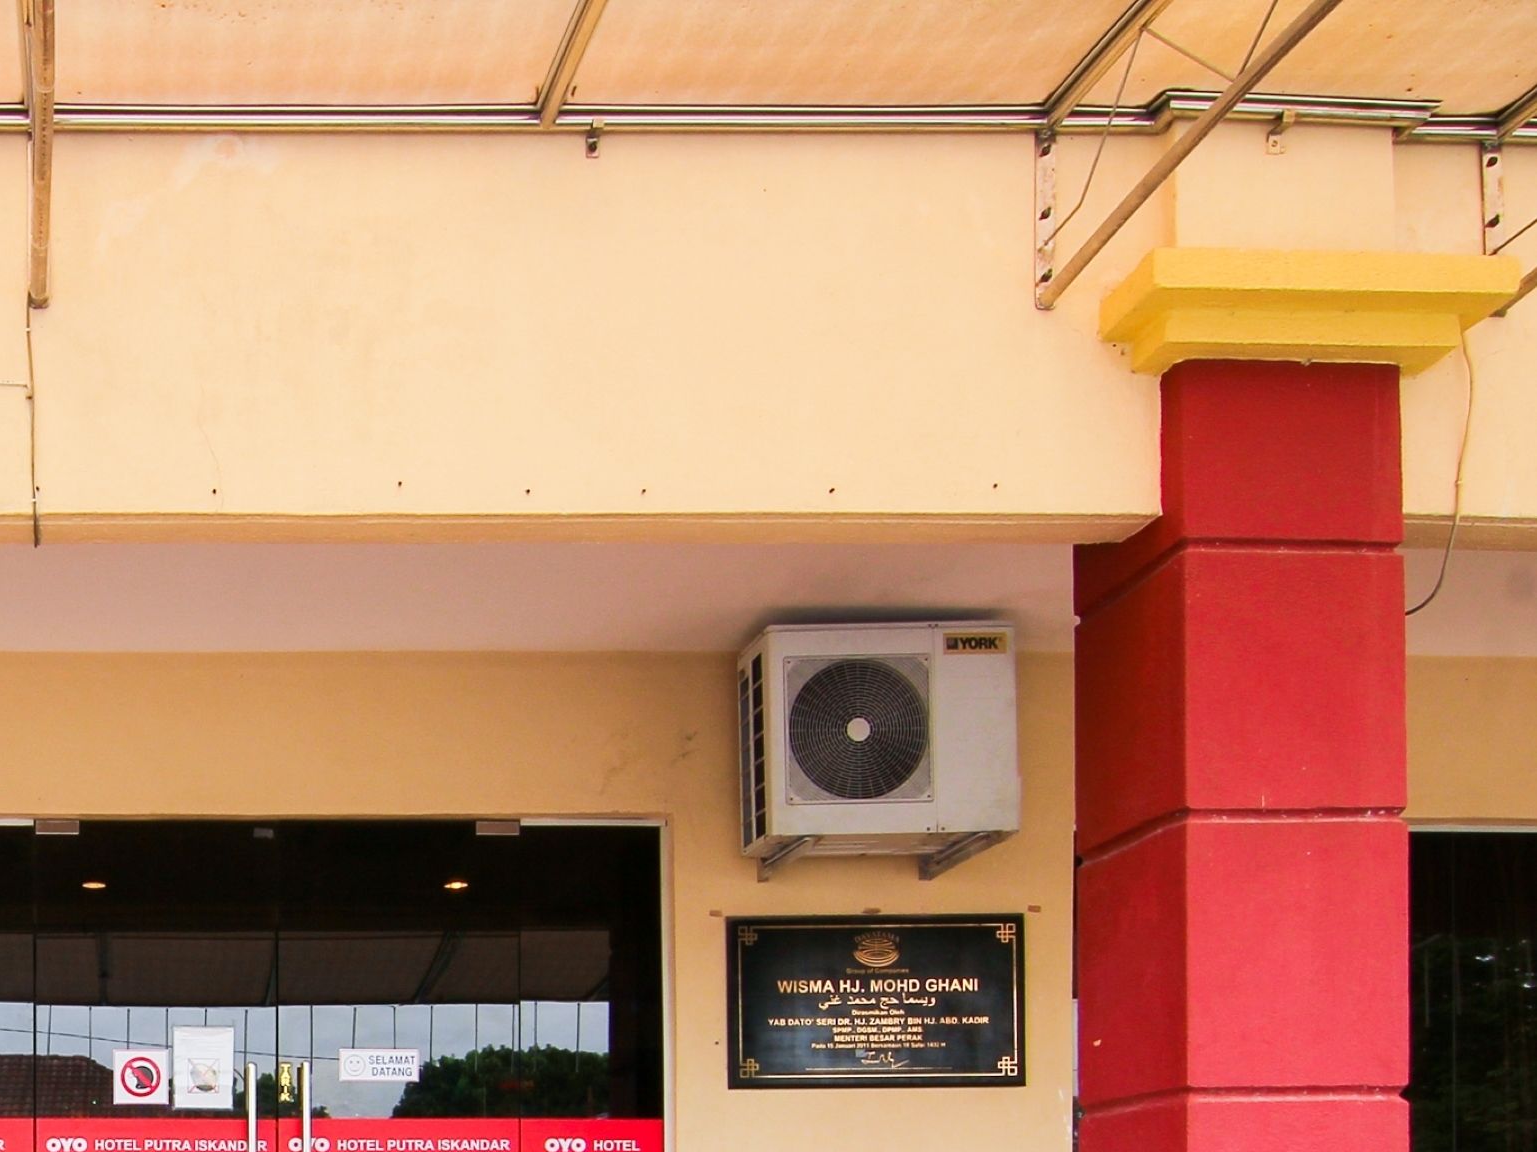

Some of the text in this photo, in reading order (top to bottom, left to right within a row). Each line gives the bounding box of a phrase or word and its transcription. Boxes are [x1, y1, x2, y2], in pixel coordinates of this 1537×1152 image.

[959, 636, 999, 650] YORK
[777, 978, 979, 993] WISMA HJ. MOHD GHANI
[767, 1018, 786, 1027] YAB
[816, 1018, 836, 1026] SERI
[868, 1016, 905, 1025] ZAMBRY
[907, 1016, 923, 1025] BIN
[961, 1016, 990, 1025] KADIR
[834, 1034, 868, 1042] MENTERI
[869, 1034, 895, 1042] BESAR
[368, 1055, 416, 1065] SELAMAT
[371, 1066, 413, 1077] DATANG
[279, 1062, 292, 1103] TARIK
[45, 1137, 268, 1152] OYO HOTEL PUTRA ISKANDR
[337, 1139, 384, 1152] HOTEL
[386, 1139, 435, 1152] PUTRA
[437, 1139, 511, 1152] ISKANDAR
[544, 1137, 641, 1152] OYO HOTEL
